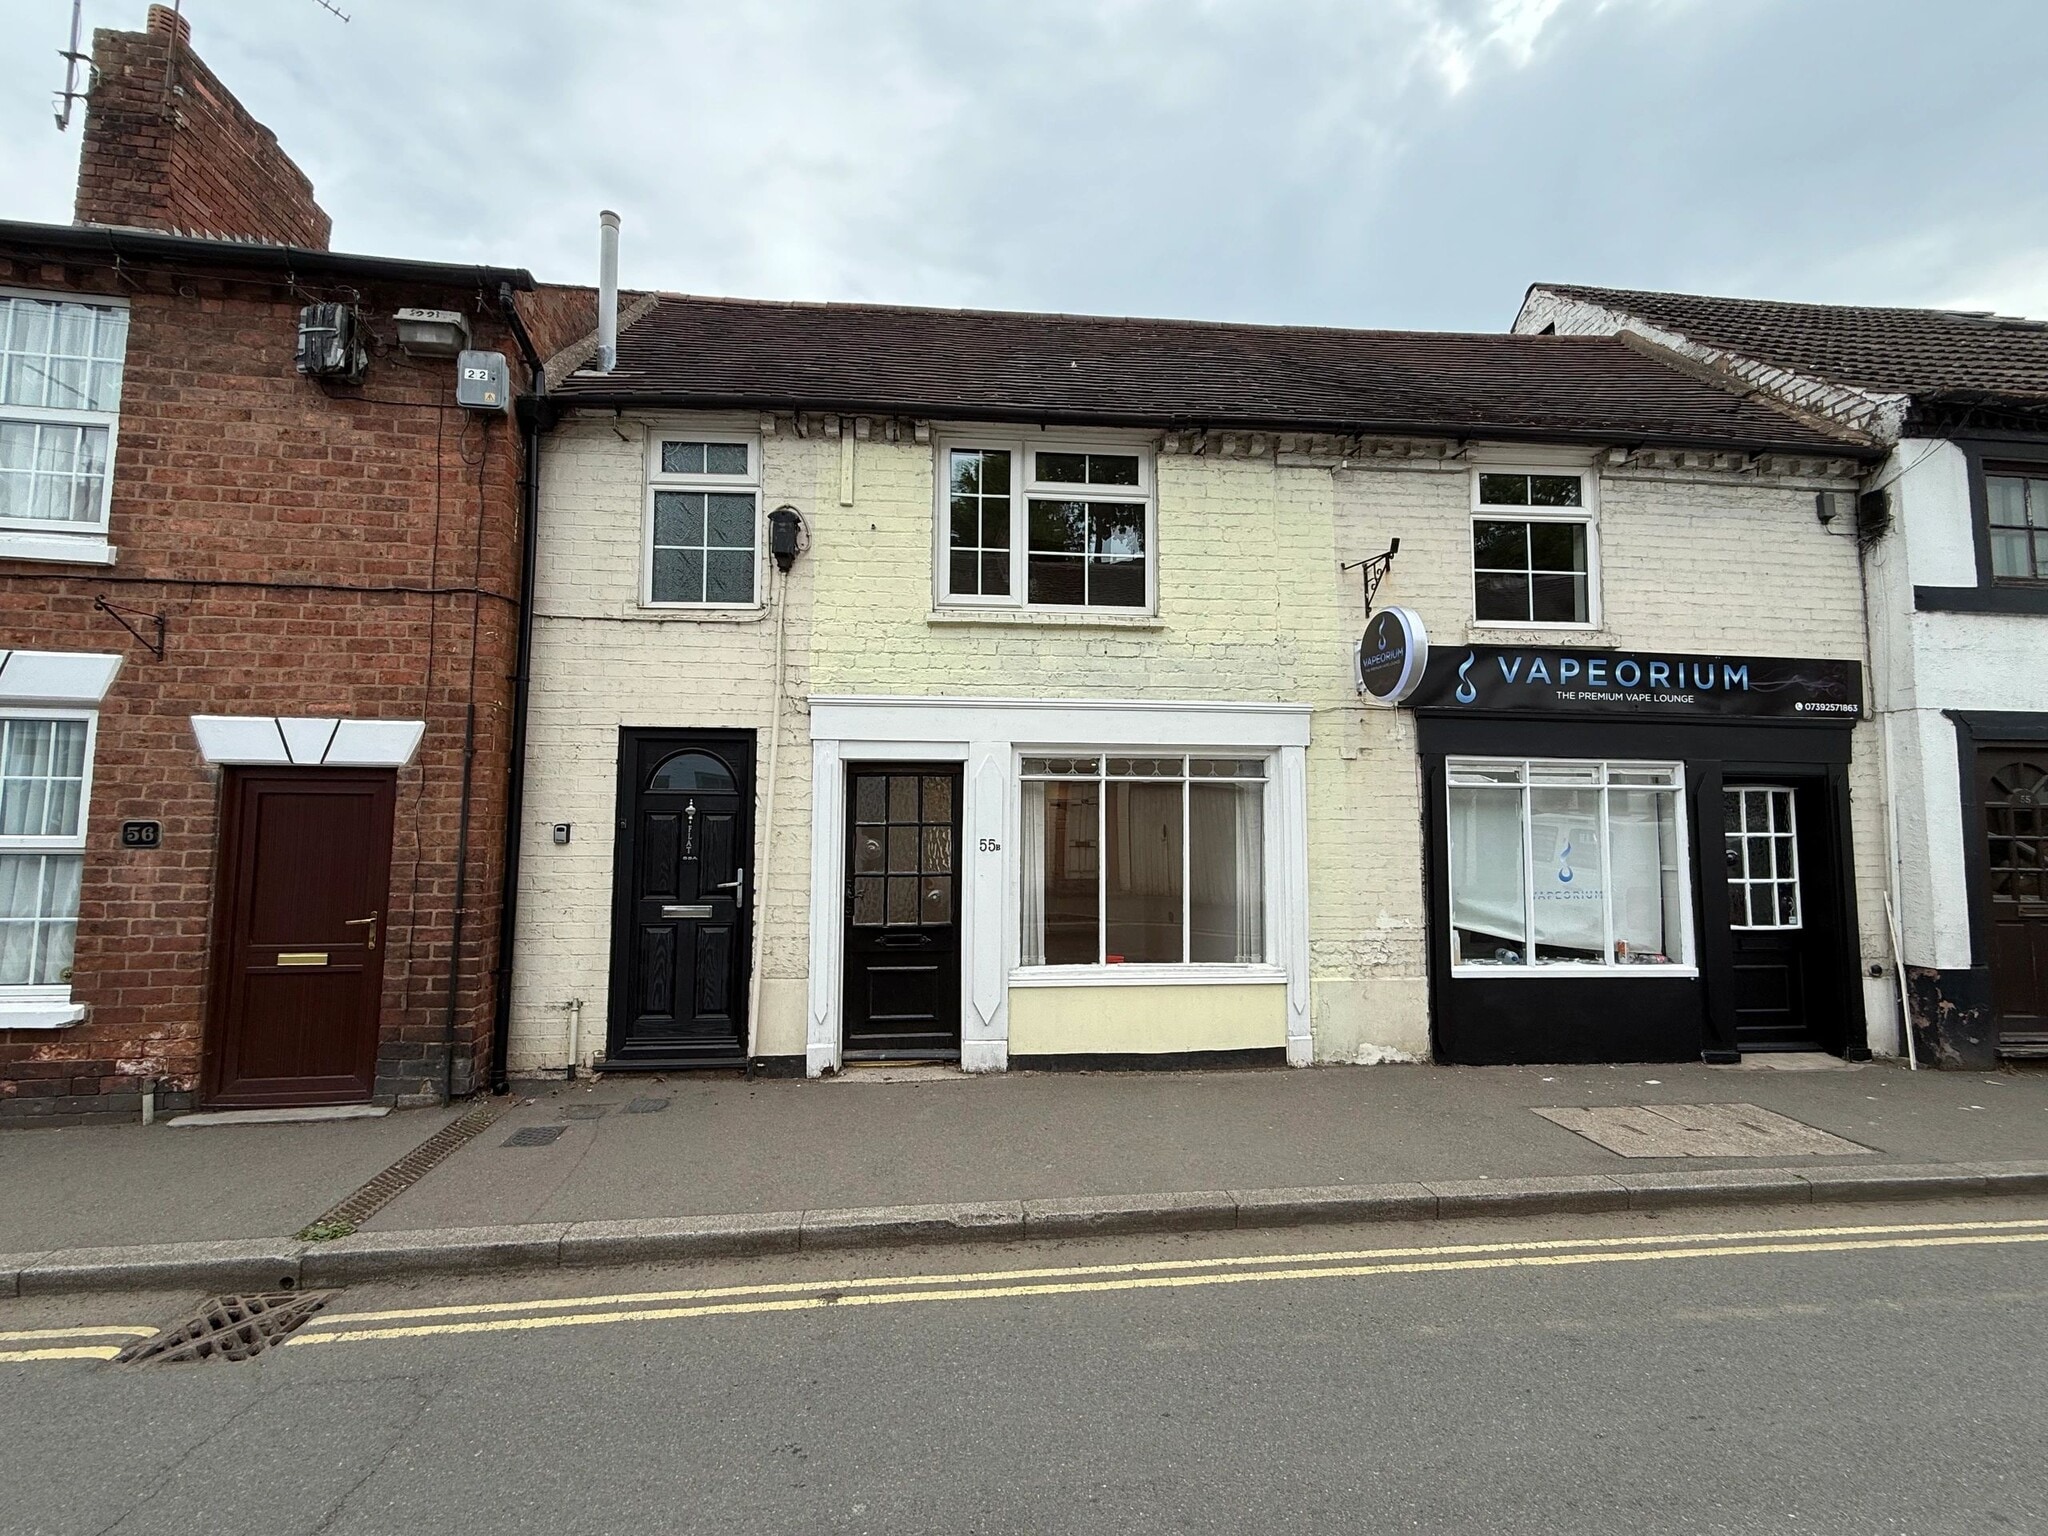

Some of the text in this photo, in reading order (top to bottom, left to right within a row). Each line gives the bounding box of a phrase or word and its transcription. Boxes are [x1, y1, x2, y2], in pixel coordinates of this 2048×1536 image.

[467, 370, 487, 380] 22
[1362, 647, 1404, 668] VAPEORIUM
[1497, 656, 1749, 691] VAPEORIUM
[1556, 691, 1695, 703] THE PREMIUM VAPE LOUNGE
[1804, 702, 1858, 712] 07392571863
[126, 826, 155, 842] 56
[685, 825, 693, 854] FLAT
[979, 838, 1001, 852] 55B
